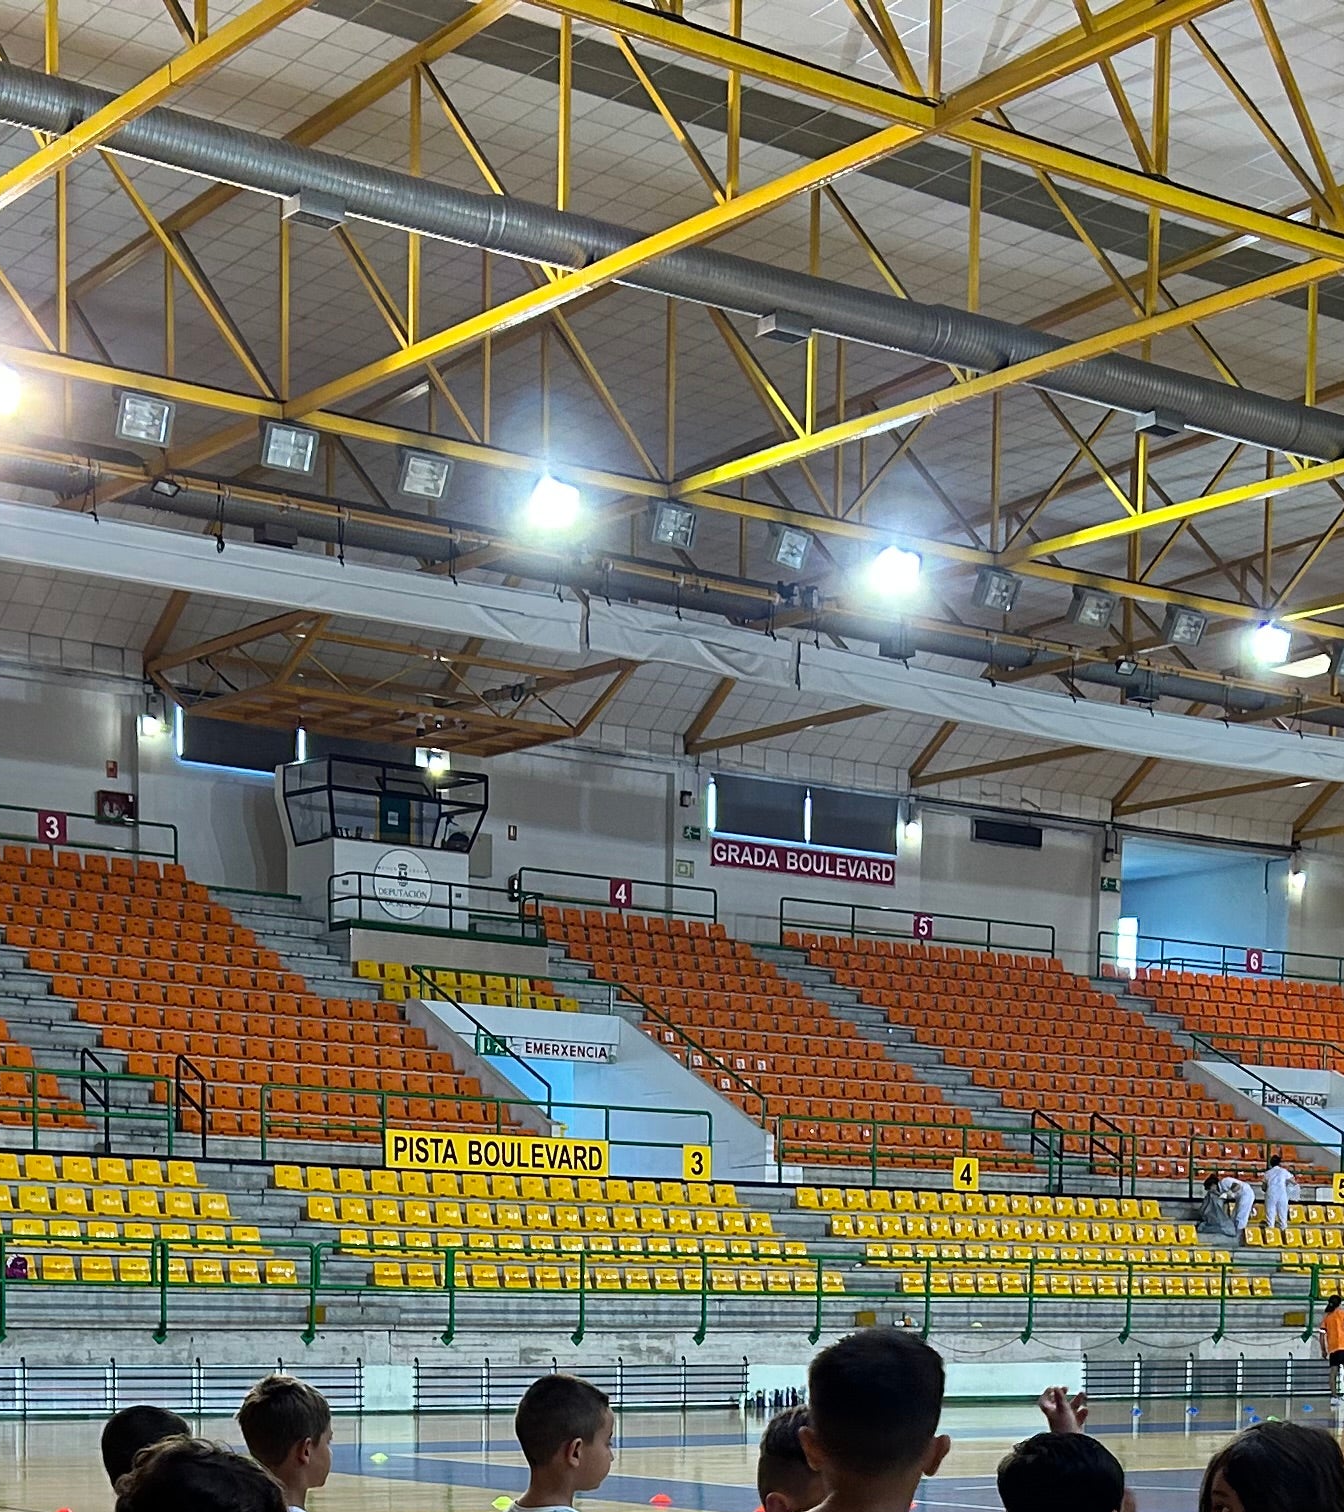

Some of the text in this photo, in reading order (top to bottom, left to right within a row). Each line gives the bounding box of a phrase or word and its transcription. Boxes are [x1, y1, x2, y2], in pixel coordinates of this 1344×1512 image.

[45, 816, 60, 839] 3
[713, 842, 894, 882] GRADA BOULEVARD
[615, 883, 627, 903] 4
[918, 918, 928, 935] 5
[1250, 953, 1259, 970] 6
[525, 1041, 608, 1059] EMERXENCIA
[394, 1136, 604, 1171] PISTA BOULEVARD
[690, 1151, 704, 1176] 3
[960, 1163, 973, 1186] 4
